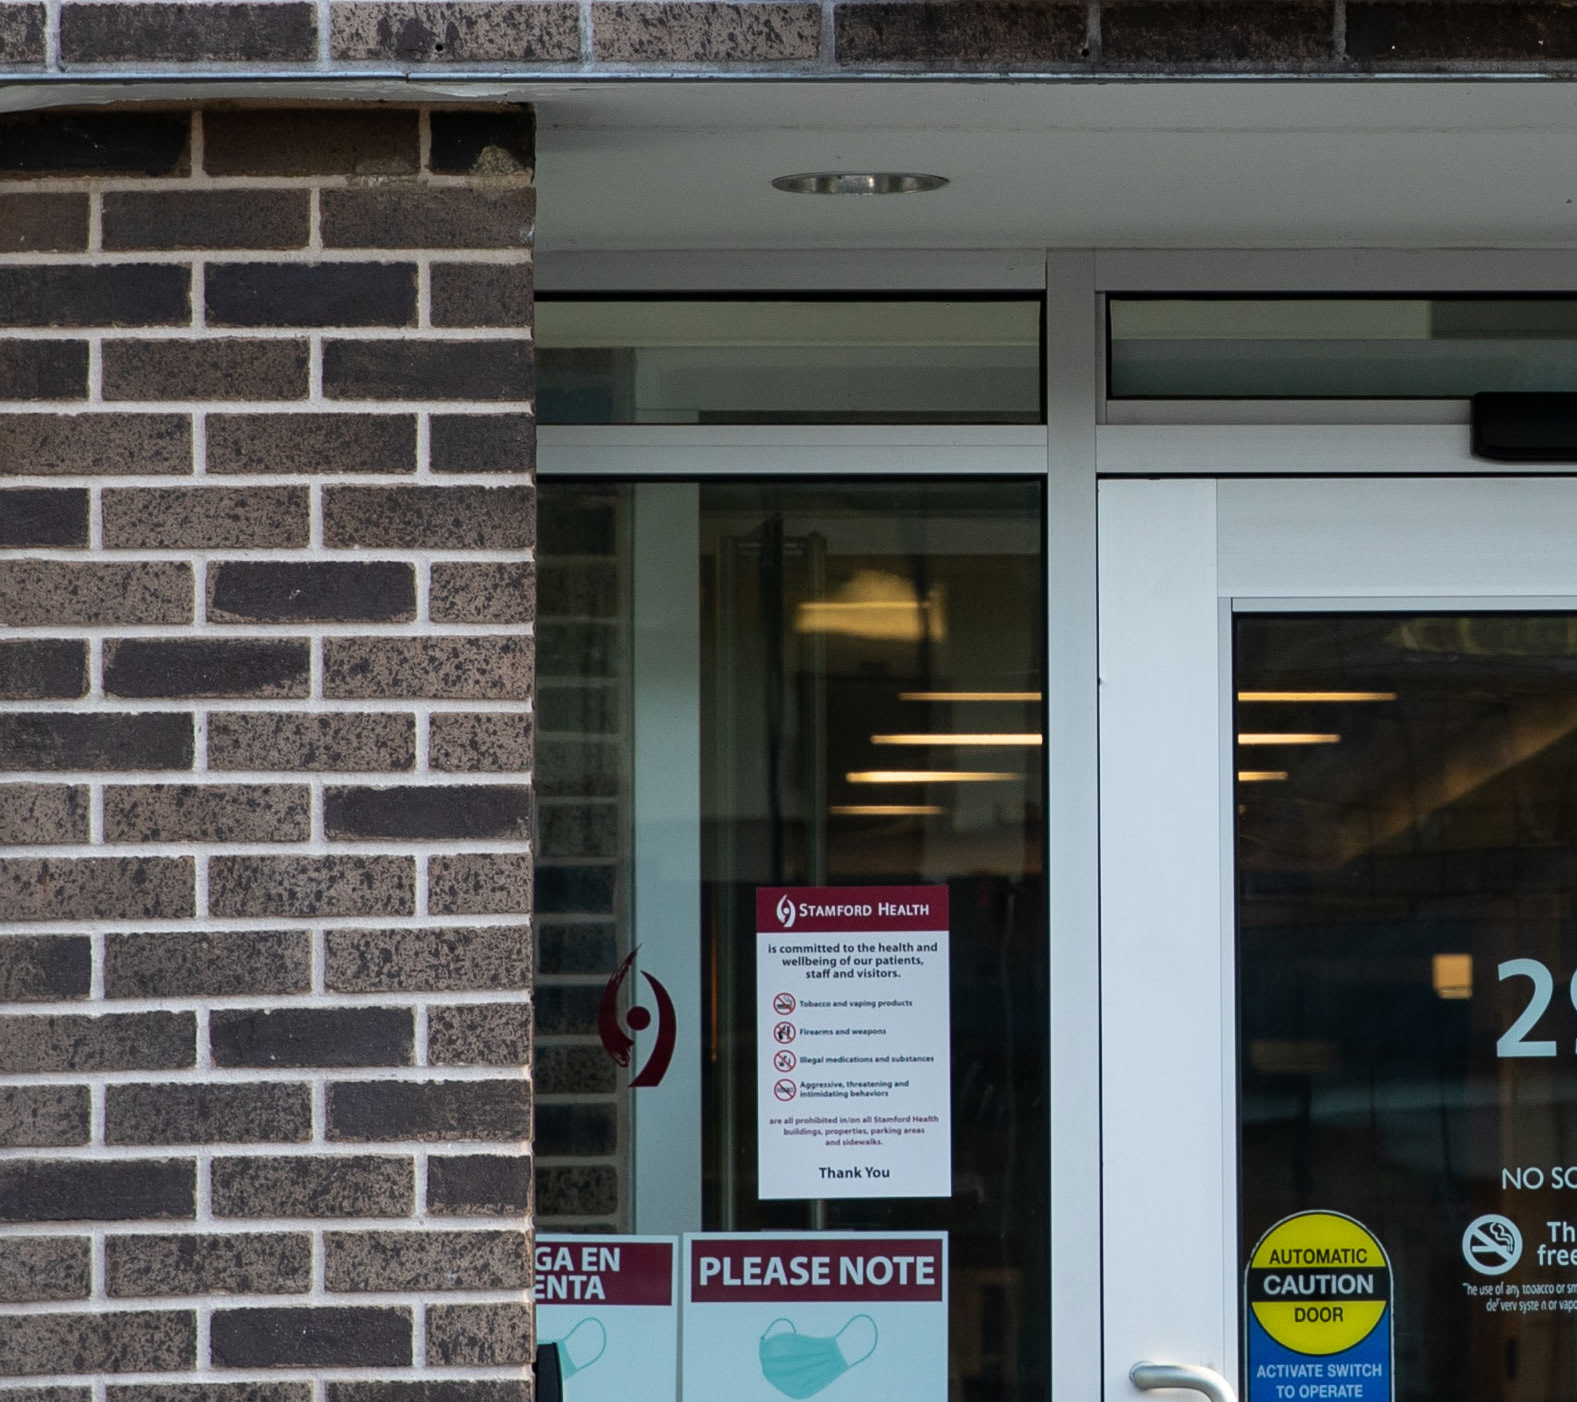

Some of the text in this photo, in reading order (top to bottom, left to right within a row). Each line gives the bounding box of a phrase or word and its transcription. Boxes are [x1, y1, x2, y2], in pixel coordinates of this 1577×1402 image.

[799, 902, 929, 917] STAMFORD HEALTH
[768, 942, 938, 954] is committed to the health and
[782, 955, 924, 969] wellbeing of our patients,
[806, 968, 901, 979] staff and visitors.
[799, 1028, 834, 1036] Firearms
[819, 1166, 890, 1179] Thank You
[1502, 1167, 1544, 1190] NO
[582, 1247, 620, 1272] EN
[1269, 1248, 1367, 1265] AUTOMATIC
[700, 1255, 935, 1286] PLEASE NOTE
[534, 1275, 606, 1300] ENTA
[1263, 1274, 1373, 1295] CAUTION
[1295, 1306, 1343, 1323] DOOR
[1256, 1363, 1382, 1378] ACTIVATE SWITCH
[1276, 1384, 1363, 1399] TO OPERATE
